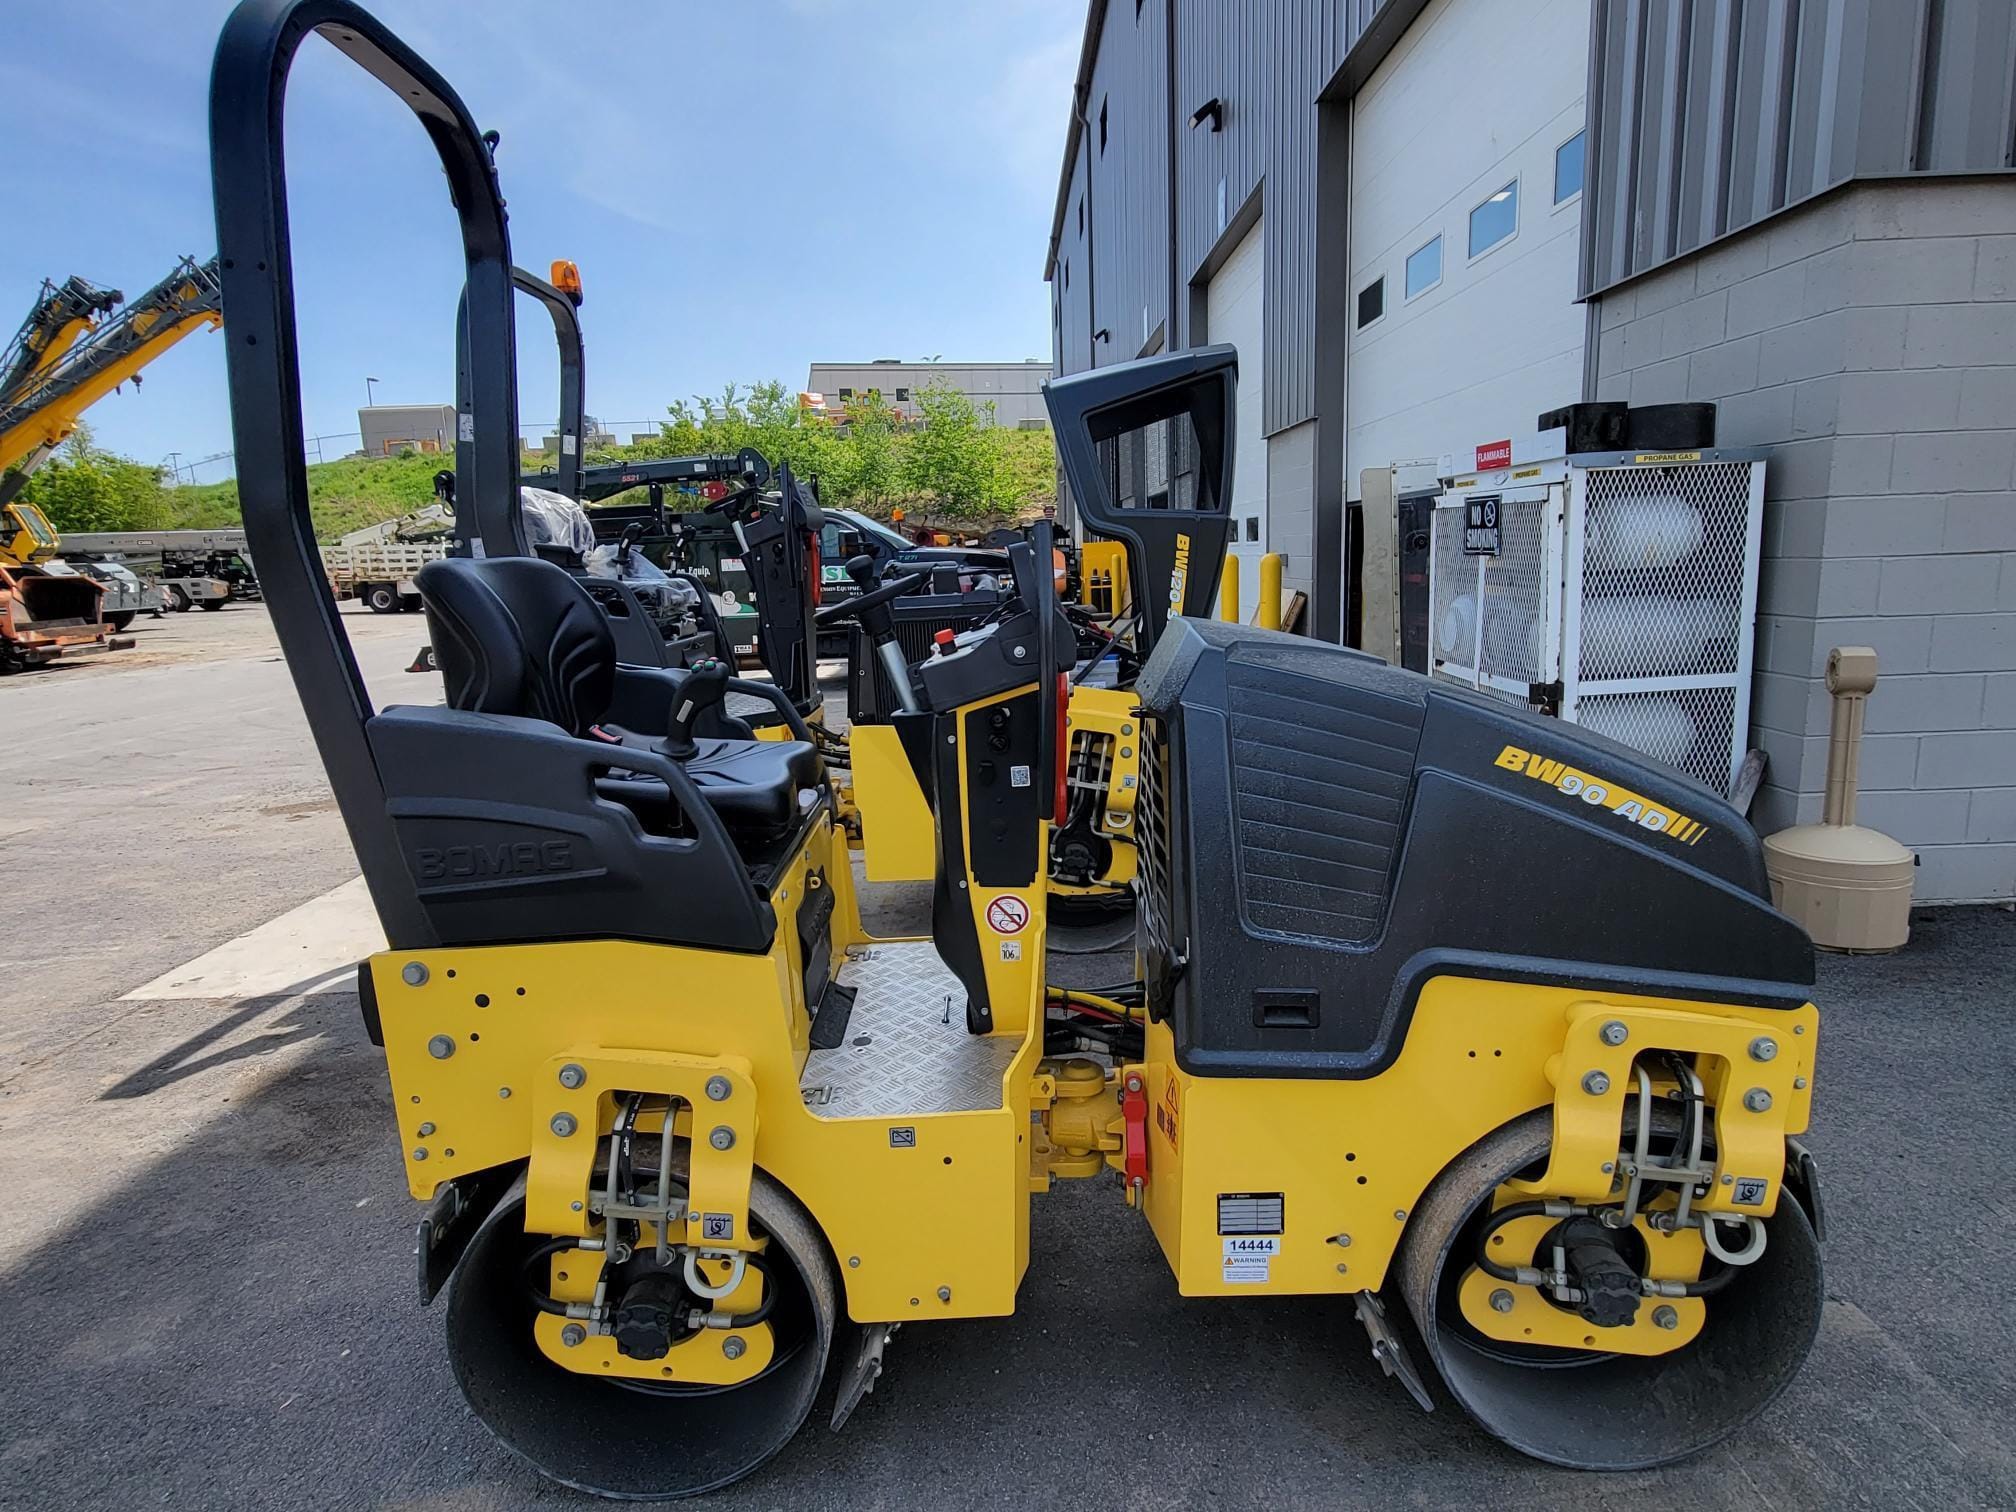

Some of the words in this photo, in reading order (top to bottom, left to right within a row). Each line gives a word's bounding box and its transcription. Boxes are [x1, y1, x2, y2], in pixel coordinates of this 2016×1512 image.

[1477, 447, 1510, 463] FLAMMABLE
[1643, 454, 1676, 462] PROPANE
[1471, 505, 1482, 526] NO
[1466, 527, 1498, 549] SMOKING
[688, 565, 711, 578] Equip.
[416, 840, 573, 879] BOMAG
[1001, 949, 1015, 959] 106
[1230, 1240, 1274, 1251] 14444
